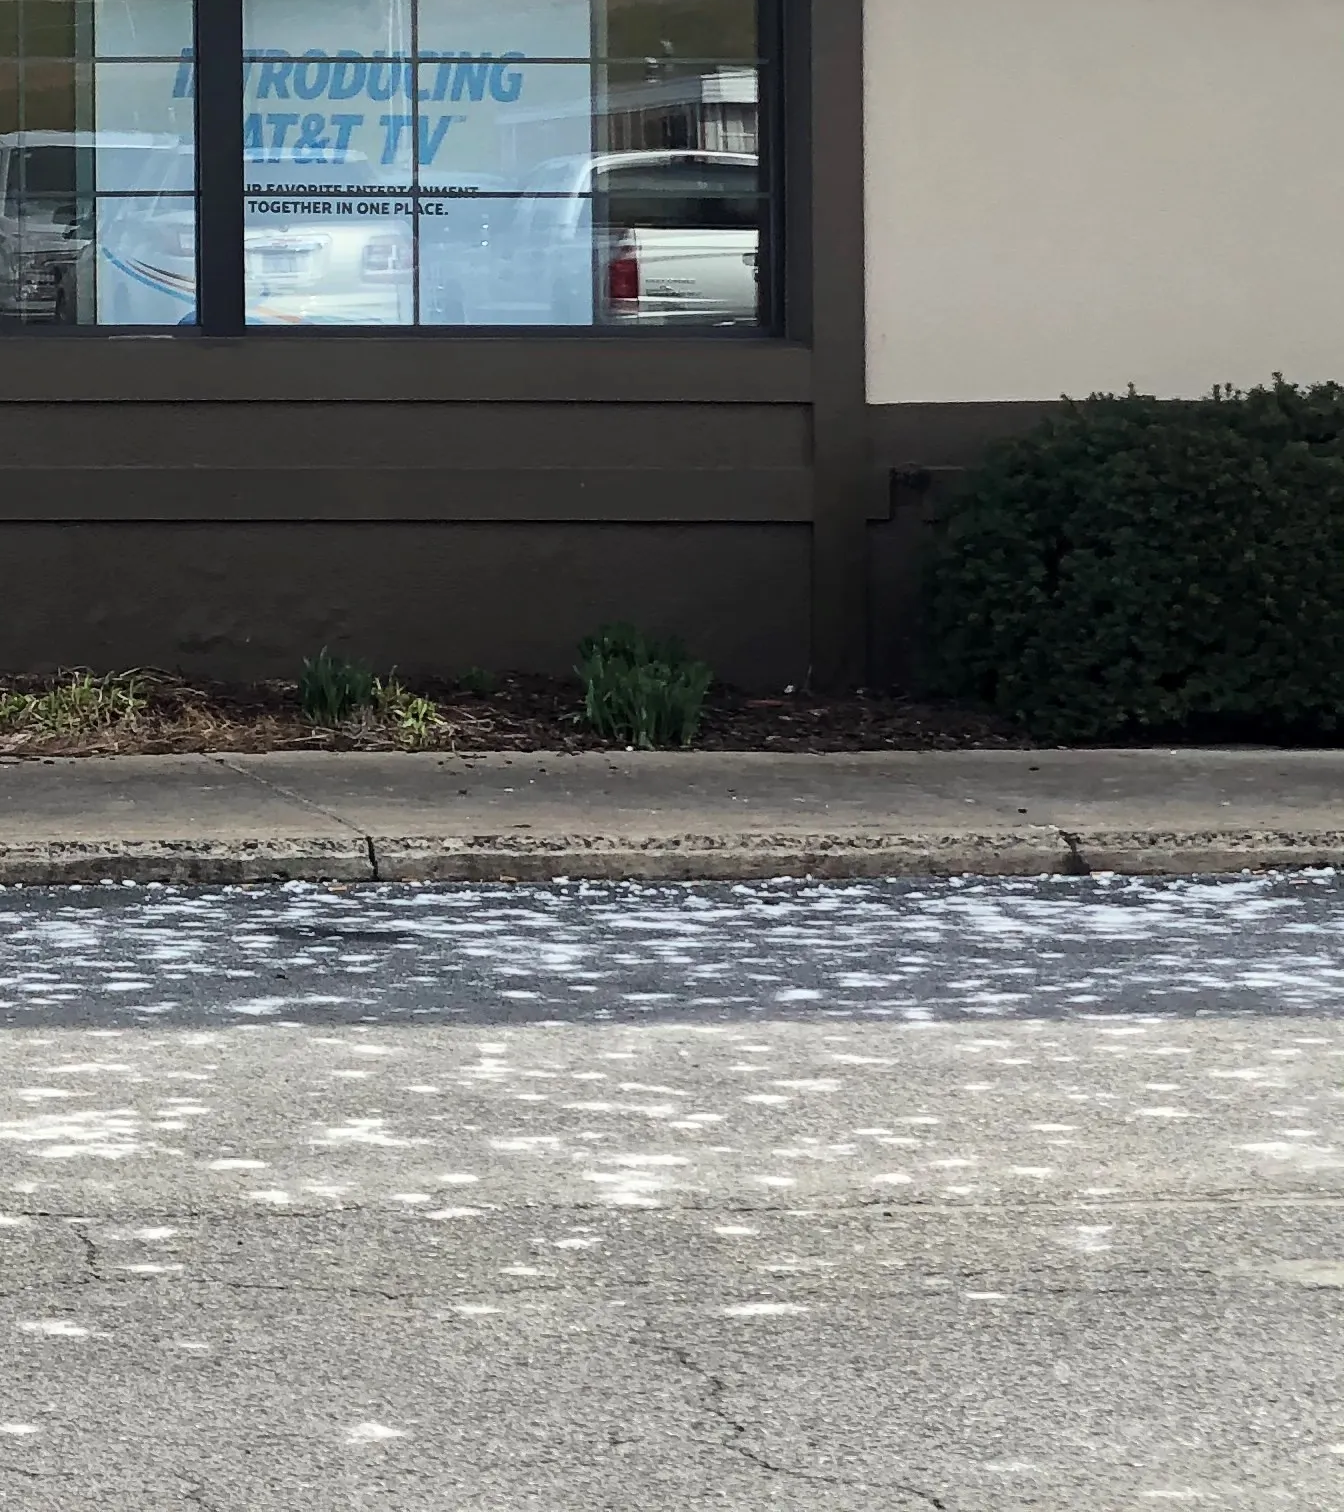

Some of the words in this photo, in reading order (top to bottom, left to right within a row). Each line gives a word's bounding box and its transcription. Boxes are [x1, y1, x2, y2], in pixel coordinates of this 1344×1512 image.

[172, 48, 525, 102] ITRODUCING
[243, 113, 363, 164] AT&T
[248, 201, 332, 214] TOGETHER
[336, 202, 353, 214] IN
[356, 202, 390, 215] ONE
[394, 202, 449, 216] PLACE.
